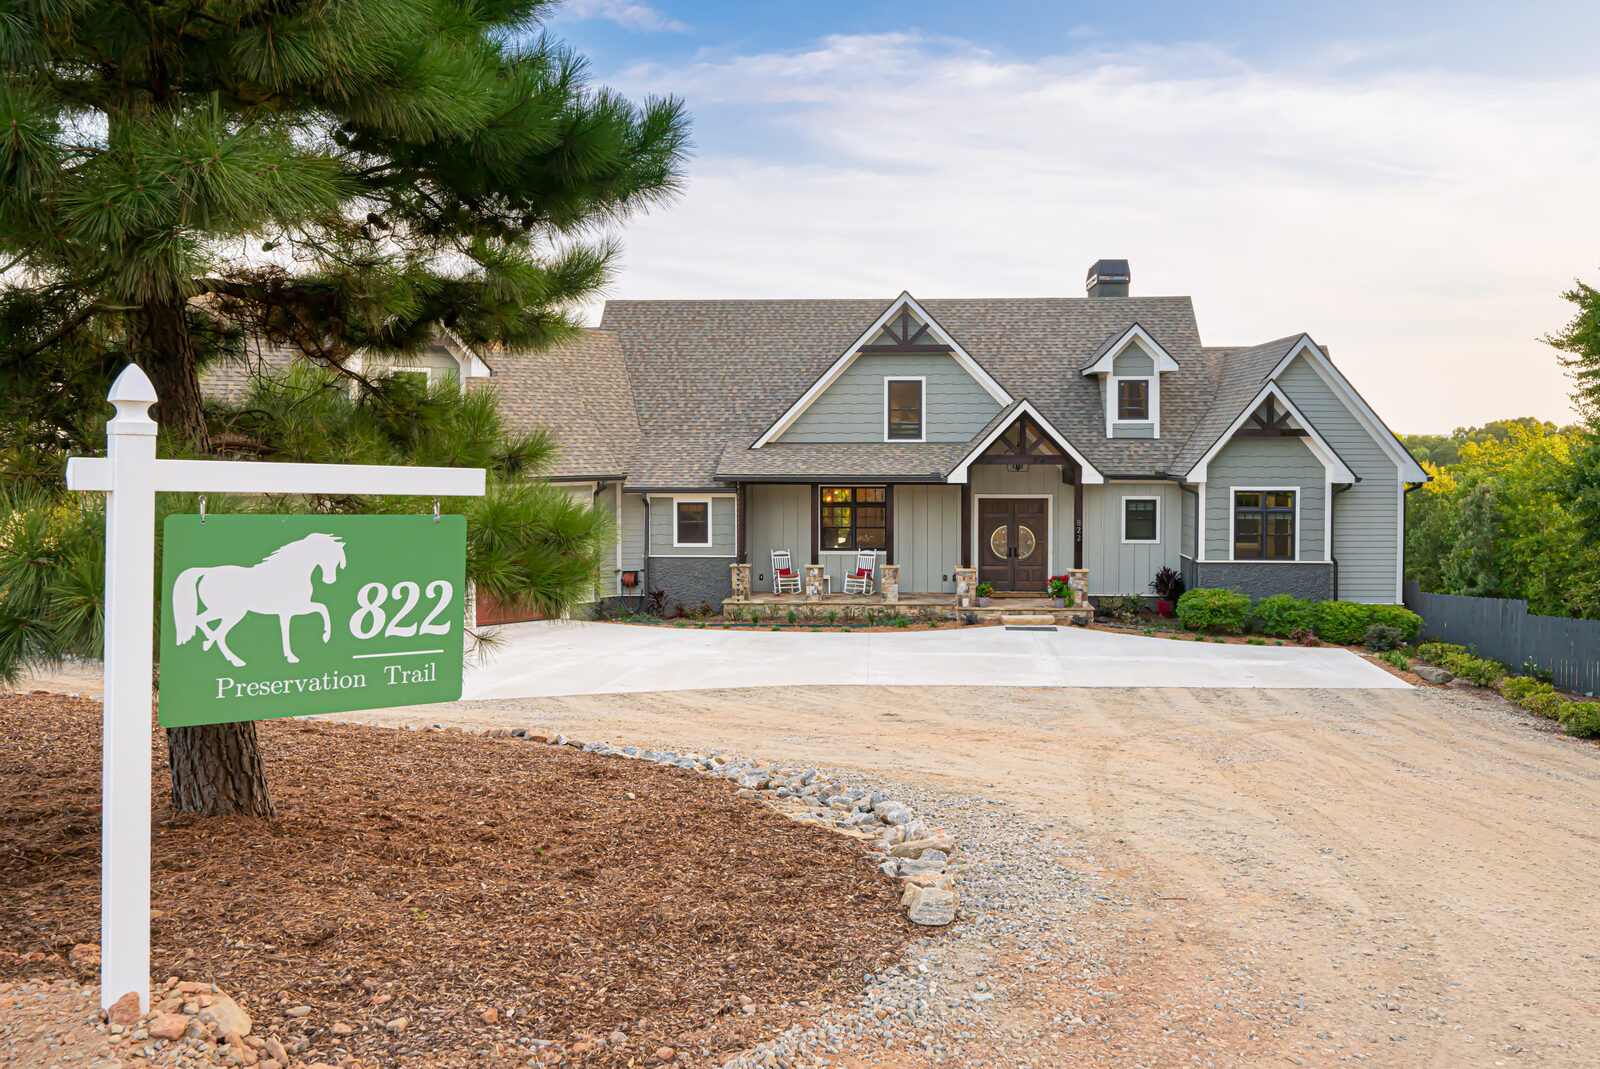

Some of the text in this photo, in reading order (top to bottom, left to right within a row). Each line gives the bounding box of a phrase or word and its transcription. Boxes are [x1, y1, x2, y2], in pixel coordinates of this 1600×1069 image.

[350, 580, 453, 639] 822
[215, 662, 436, 699] Preservation Trail
